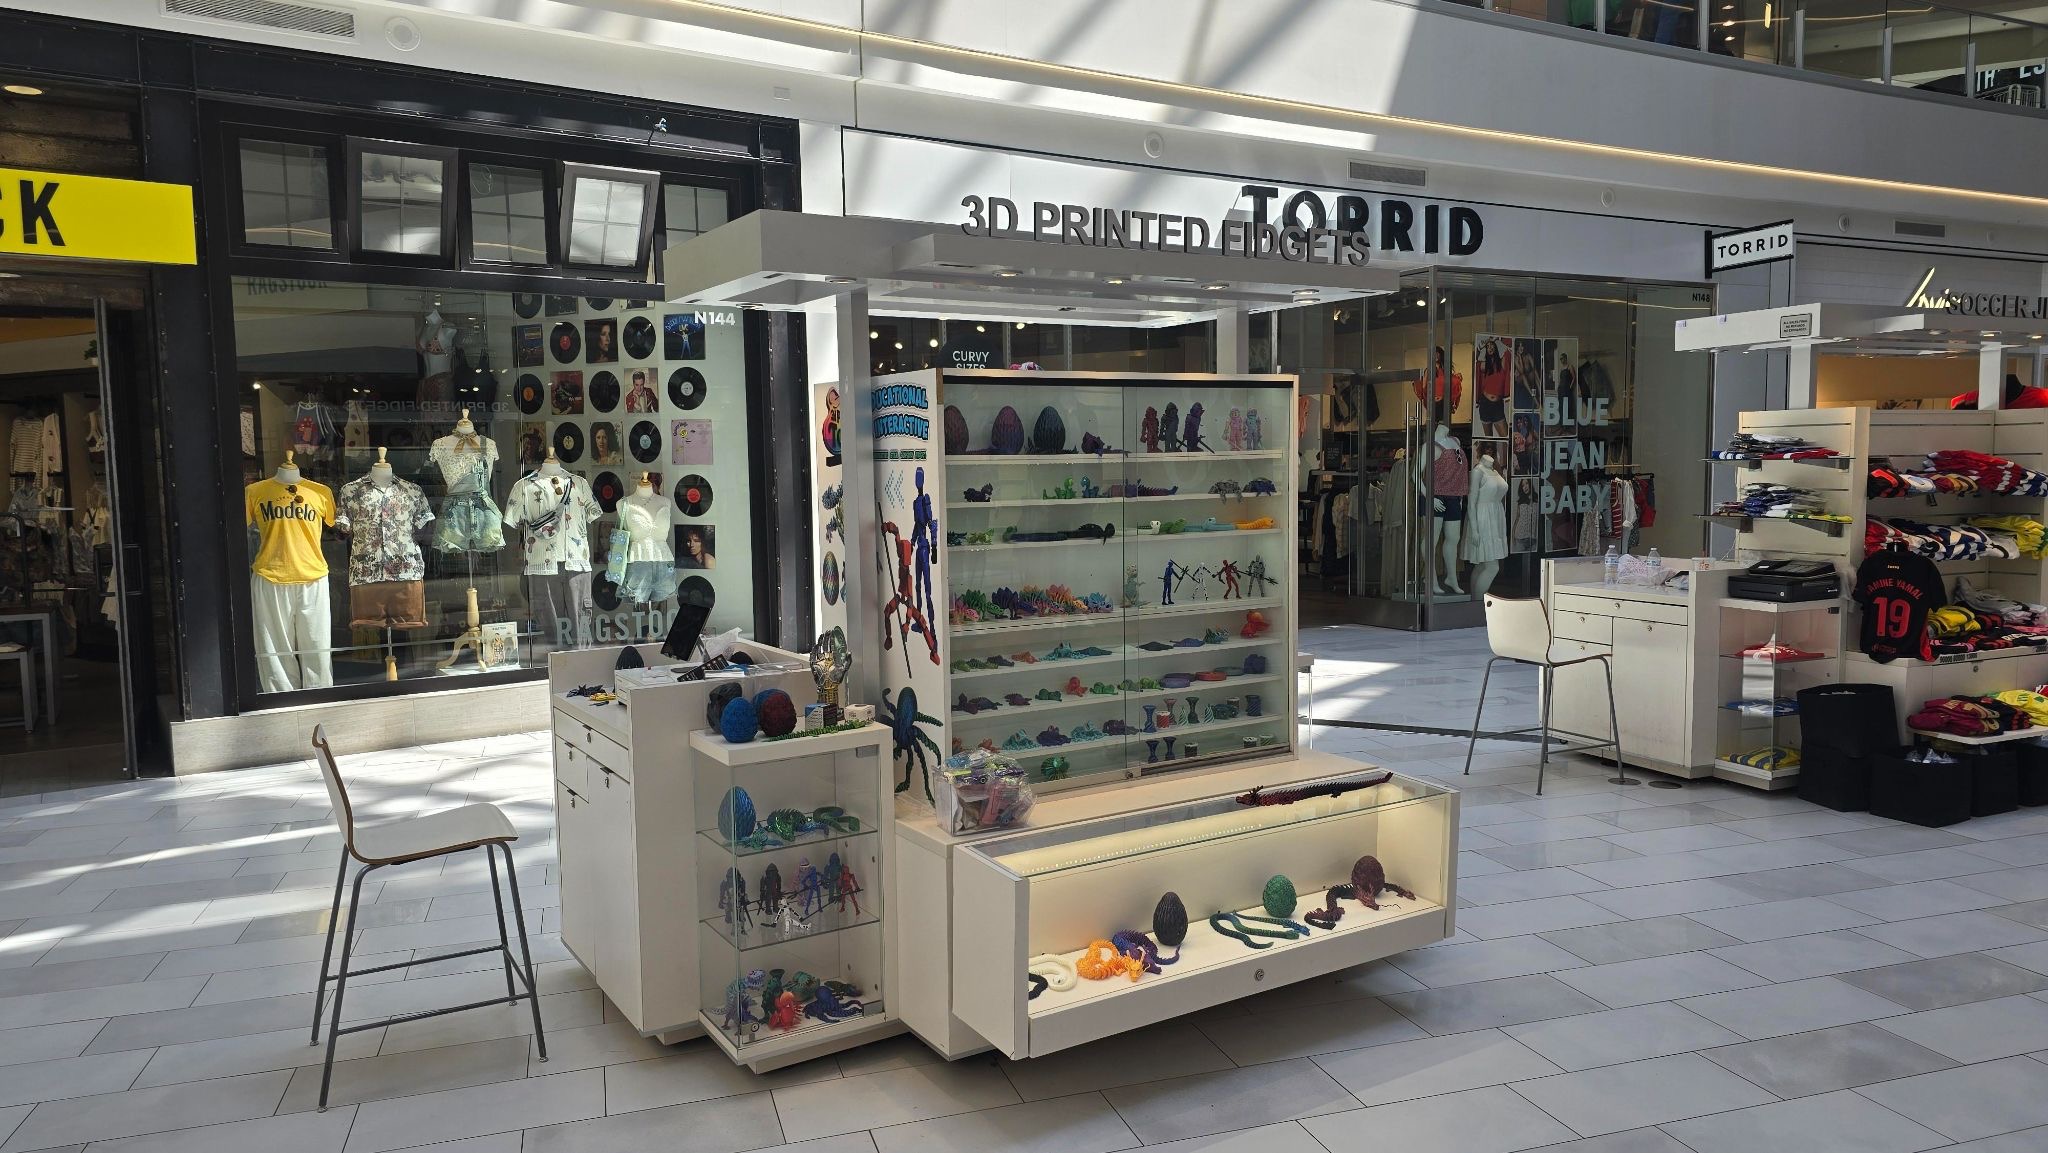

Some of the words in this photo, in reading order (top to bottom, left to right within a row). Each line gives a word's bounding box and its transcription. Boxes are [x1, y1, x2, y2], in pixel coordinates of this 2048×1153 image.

[0, 179, 66, 247] K
[1242, 184, 1484, 257] TORRID
[960, 194, 1019, 237] 3D
[1033, 201, 1211, 253] PRINTED
[1221, 219, 1371, 267] FIDGETS
[1718, 234, 1788, 258] TORRID
[1692, 293, 1711, 303] N148
[1946, 291, 2027, 319] SOCCER
[694, 310, 736, 326] N144
[952, 350, 990, 363] CURVY
[871, 384, 929, 411] DUCATIONAL
[1543, 396, 1609, 426] BLUE
[1541, 441, 1605, 479] JEAN
[260, 500, 316, 522] Modelo
[1540, 484, 1611, 514] BABY
[1866, 578, 1895, 594] AMINE
[1896, 580, 1924, 600] YAMAL
[555, 609, 680, 647] RAGSTO
[1873, 597, 1911, 638] 19
